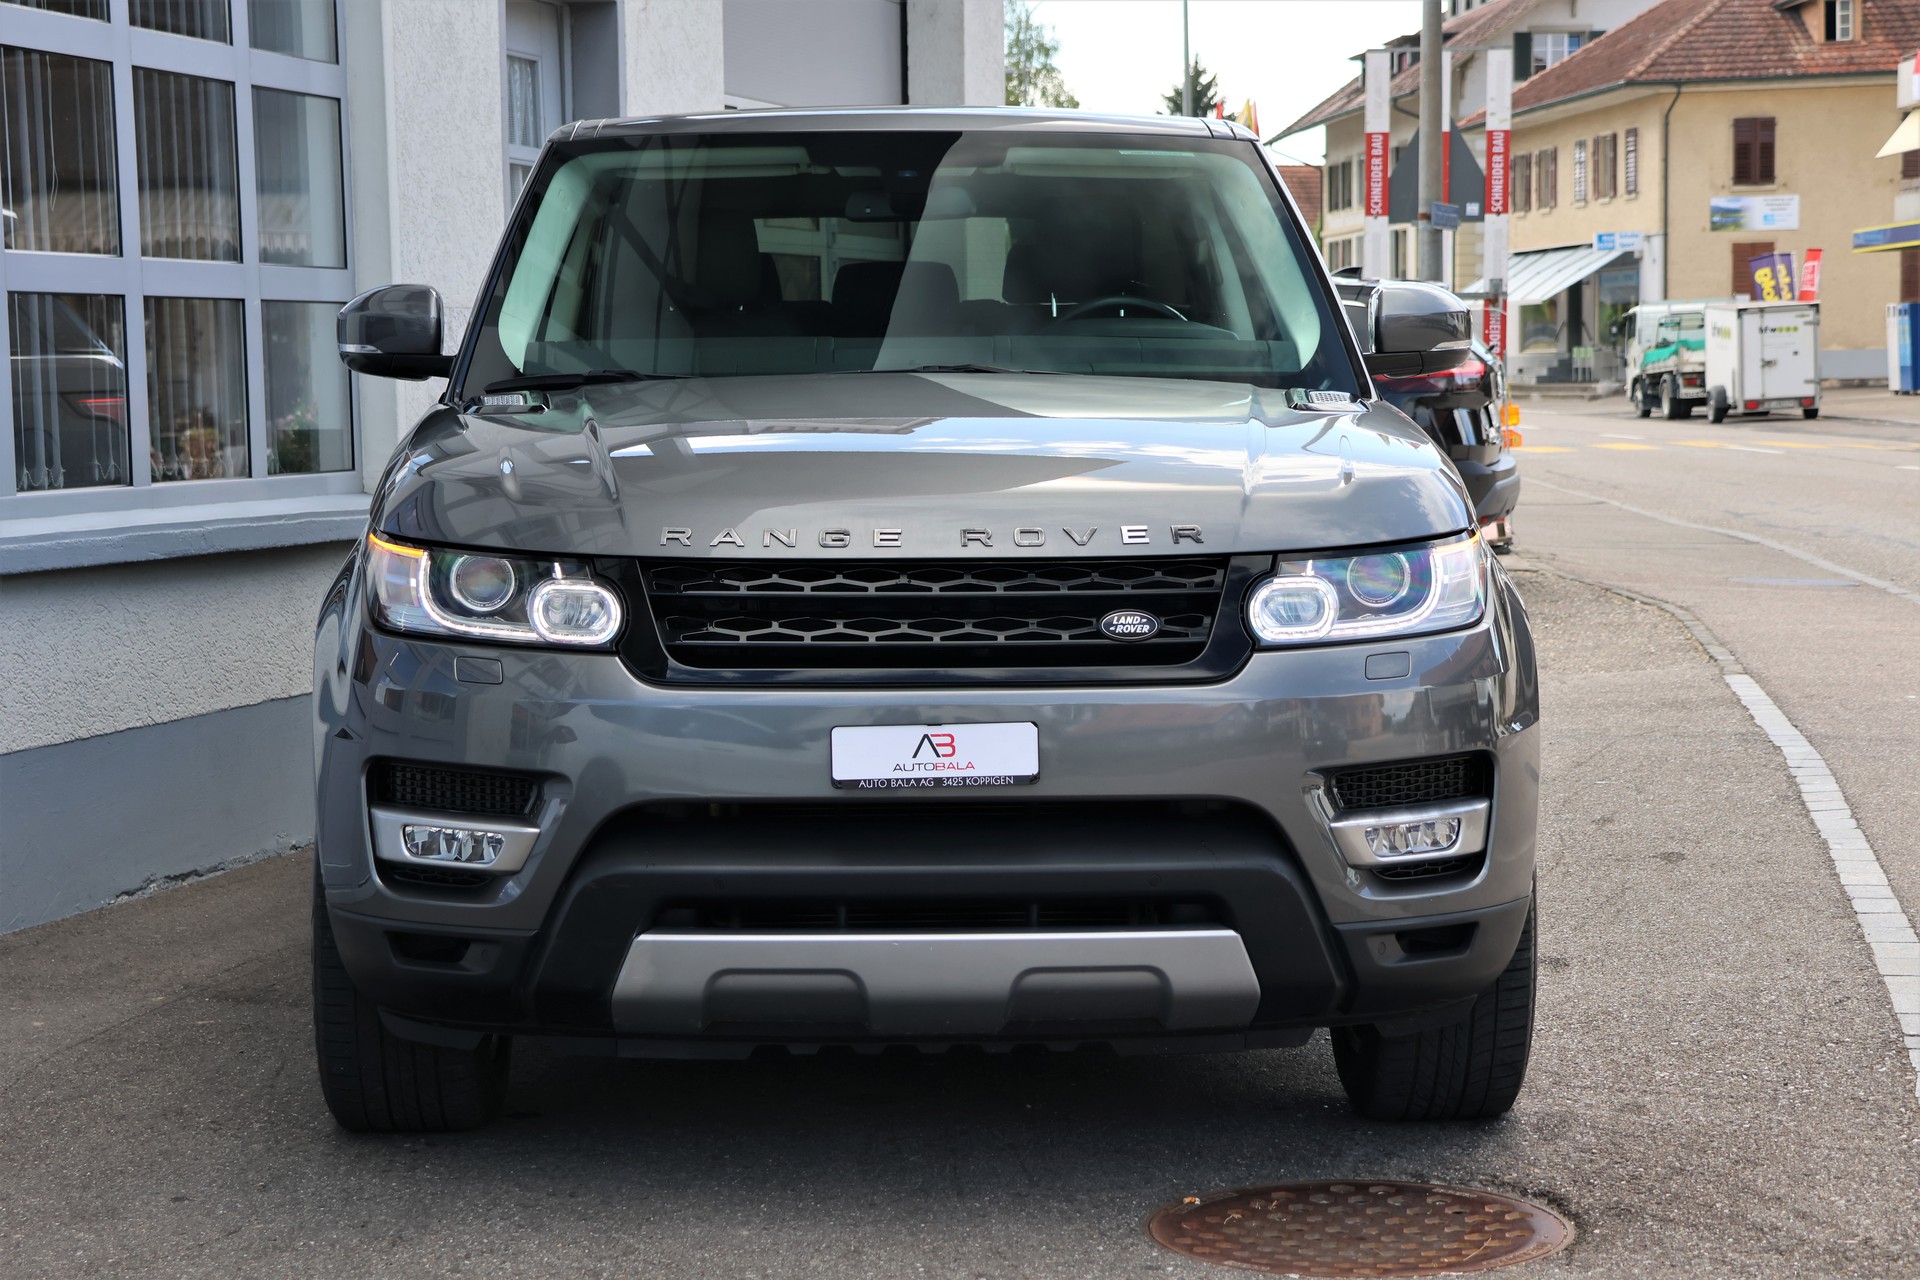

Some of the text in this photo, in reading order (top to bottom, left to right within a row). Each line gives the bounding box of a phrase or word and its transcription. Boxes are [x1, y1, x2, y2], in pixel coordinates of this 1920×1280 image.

[1370, 134, 1384, 215] SCHNEIDER BAU
[1490, 131, 1505, 212] SCHNEIDER BAU
[660, 524, 1205, 548] RANGE ROVER
[1112, 616, 1141, 625] LAND
[1115, 624, 1150, 634] ROVER
[892, 761, 976, 773] AUTOBALA
[858, 775, 1015, 789] AUTO BALA AG 3425 KOPPIGEN
